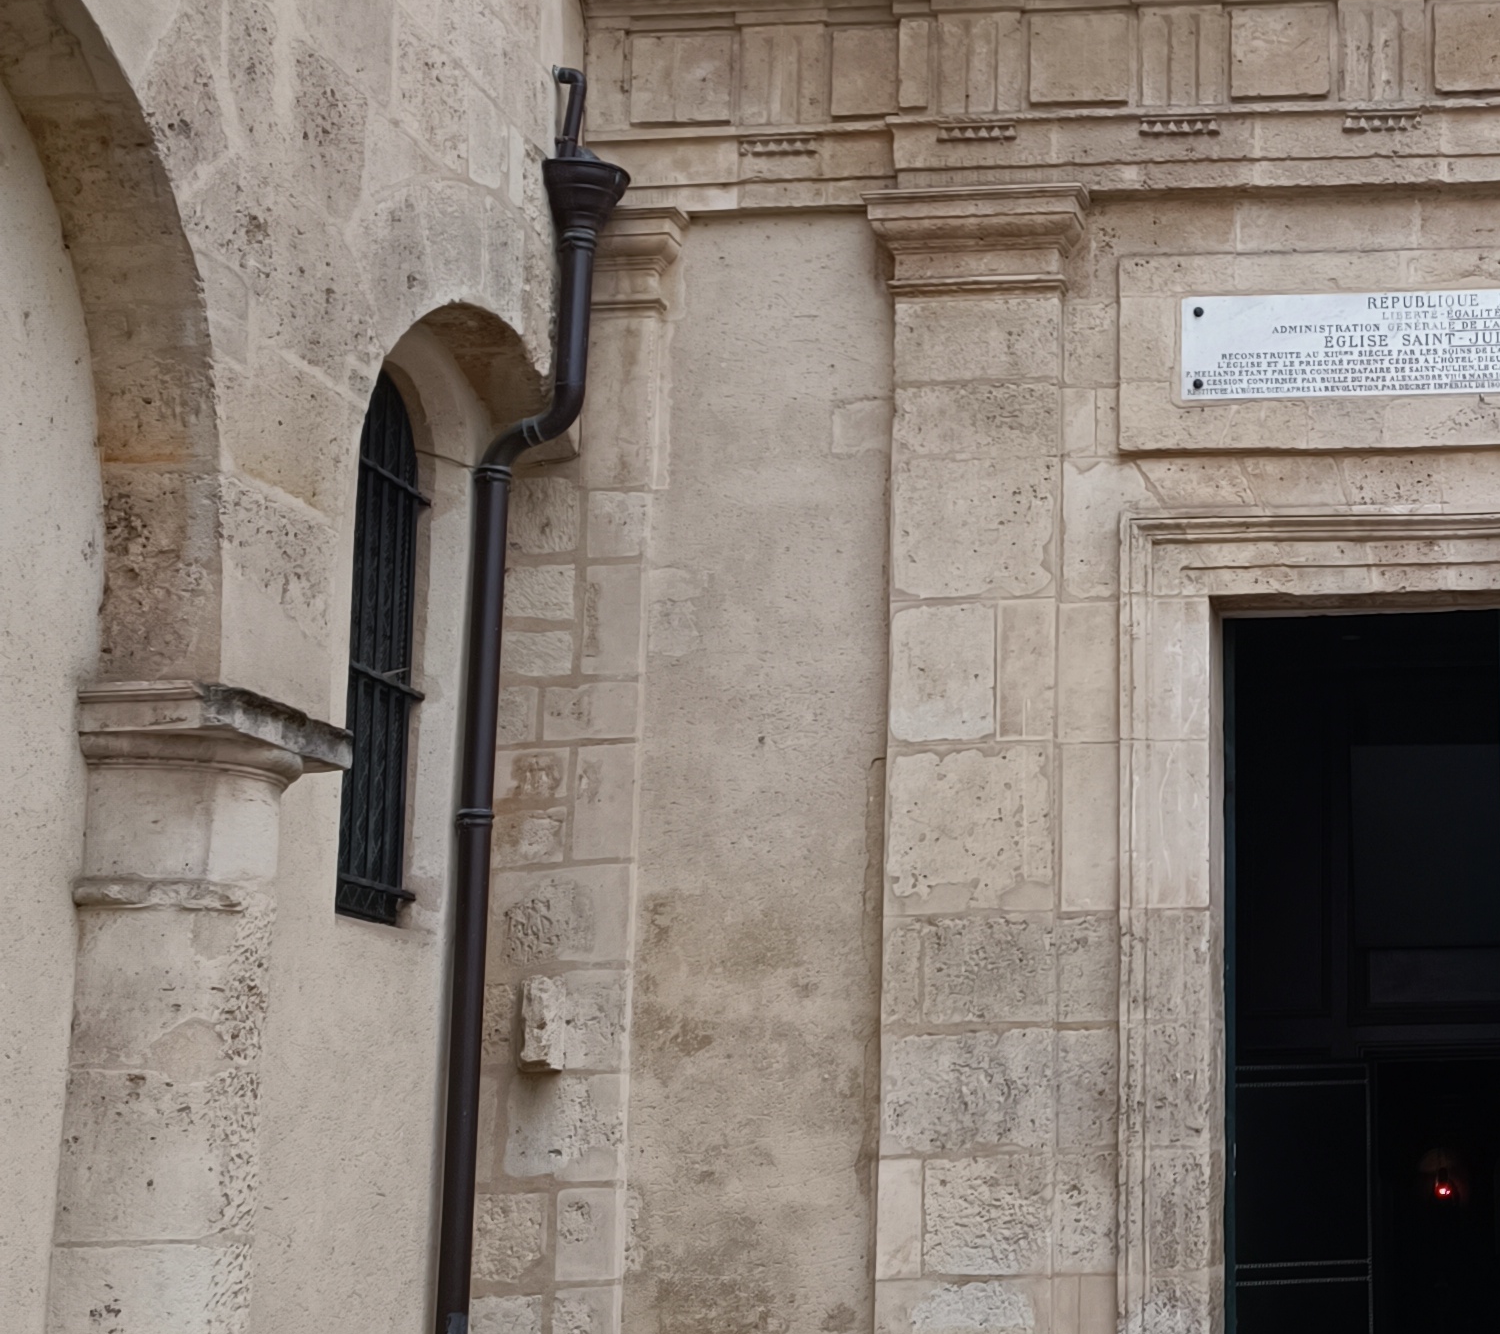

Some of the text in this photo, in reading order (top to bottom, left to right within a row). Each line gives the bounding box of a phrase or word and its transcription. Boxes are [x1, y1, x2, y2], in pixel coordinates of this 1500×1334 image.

[1367, 293, 1479, 310] RÉPUBLIQUE
[1272, 322, 1380, 334] ADMINISTRATION
[1462, 320, 1477, 330] DE
[1324, 333, 1389, 349] ÉGLISE
[1221, 351, 1301, 360] RECONSTRUITE
[1397, 349, 1416, 357] PAR
[1420, 348, 1438, 356] LES
[1442, 347, 1472, 355] SOINS
[1283, 360, 1295, 368] LE
[1299, 358, 1344, 367] PRIEURÉ
[1346, 358, 1385, 366] FURENT
[1310, 367, 1391, 375] COMMENDATAIRE
[1389, 374, 1443, 382] ALEXANDRE
